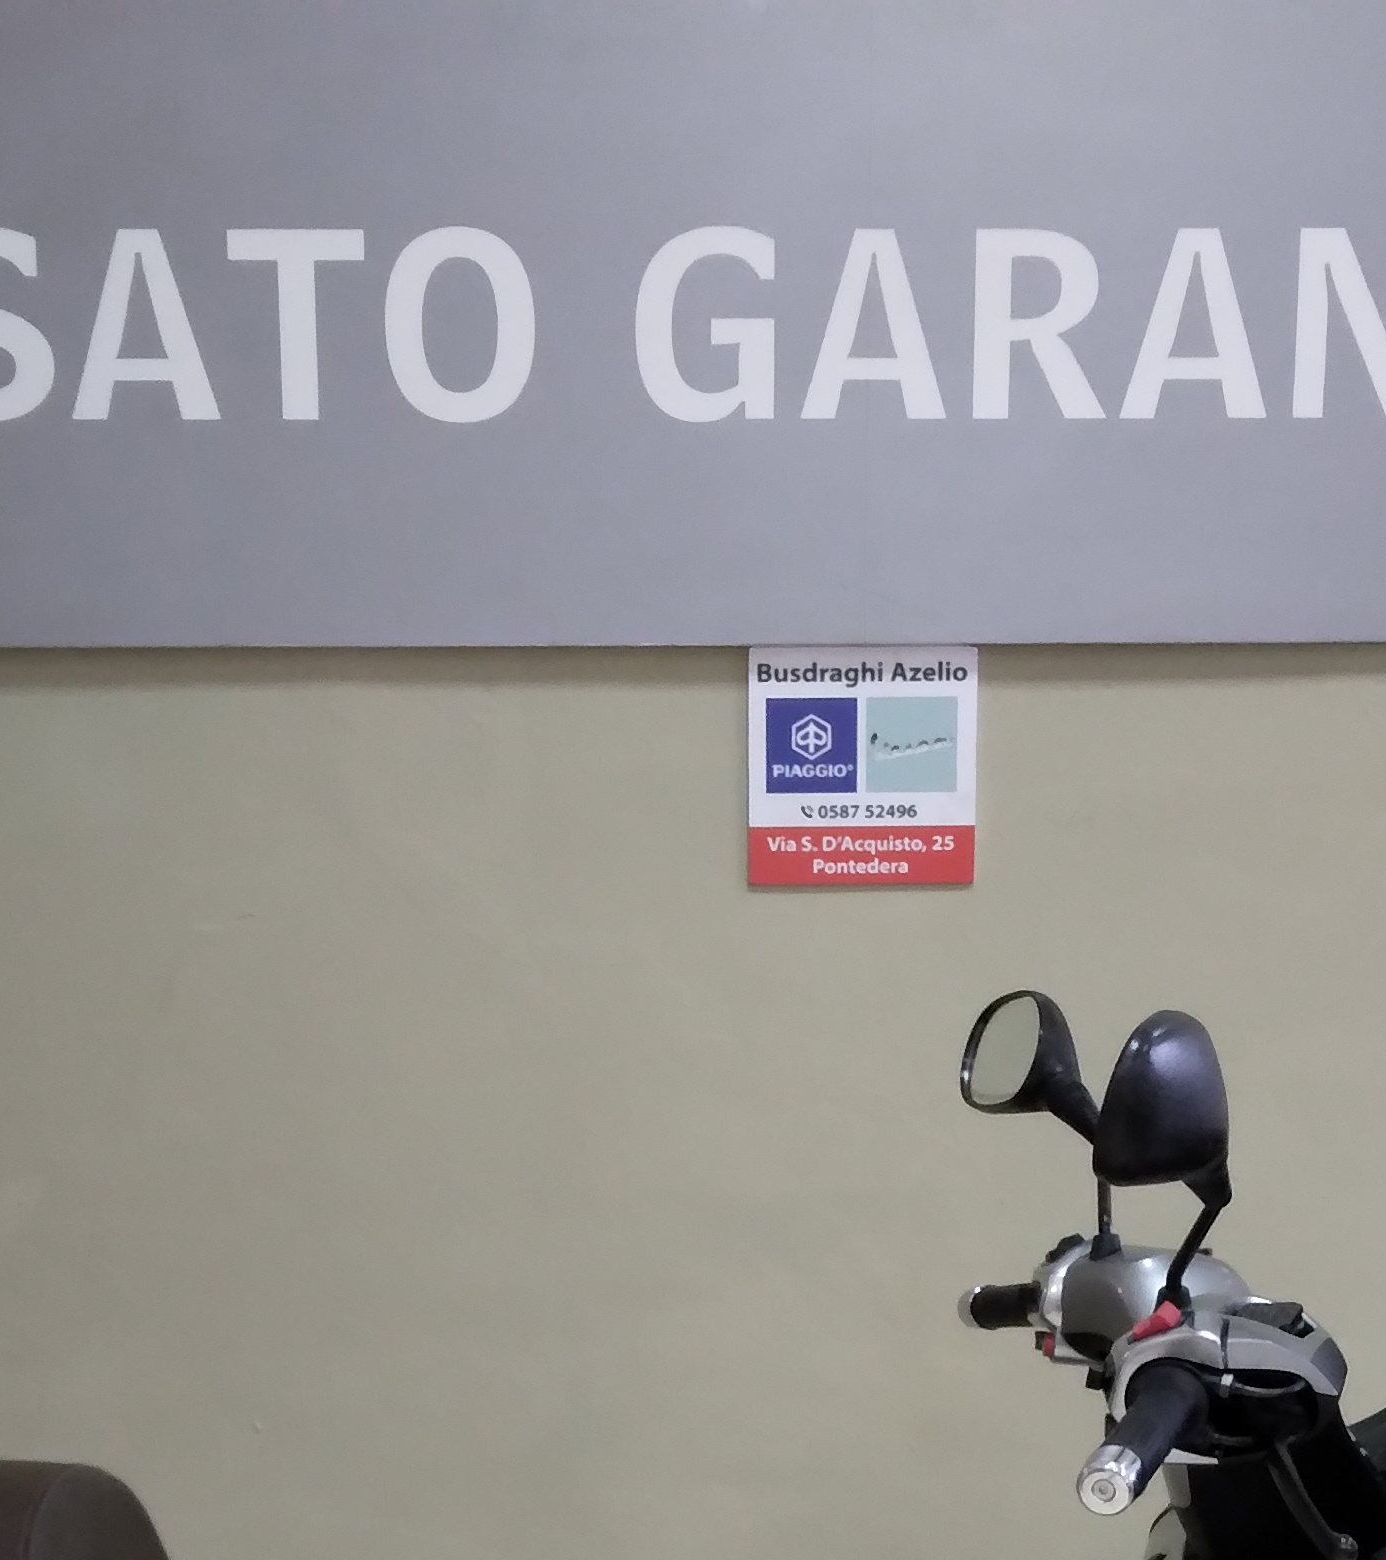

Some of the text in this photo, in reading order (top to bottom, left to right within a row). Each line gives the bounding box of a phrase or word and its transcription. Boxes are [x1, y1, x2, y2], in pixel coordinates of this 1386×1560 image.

[756, 661, 968, 688] Busdraghi Azelio
[817, 804, 918, 819] 0587 52496
[766, 835, 955, 855] Via S. D'Acquisto, 25
[812, 857, 910, 875] Pontedera
